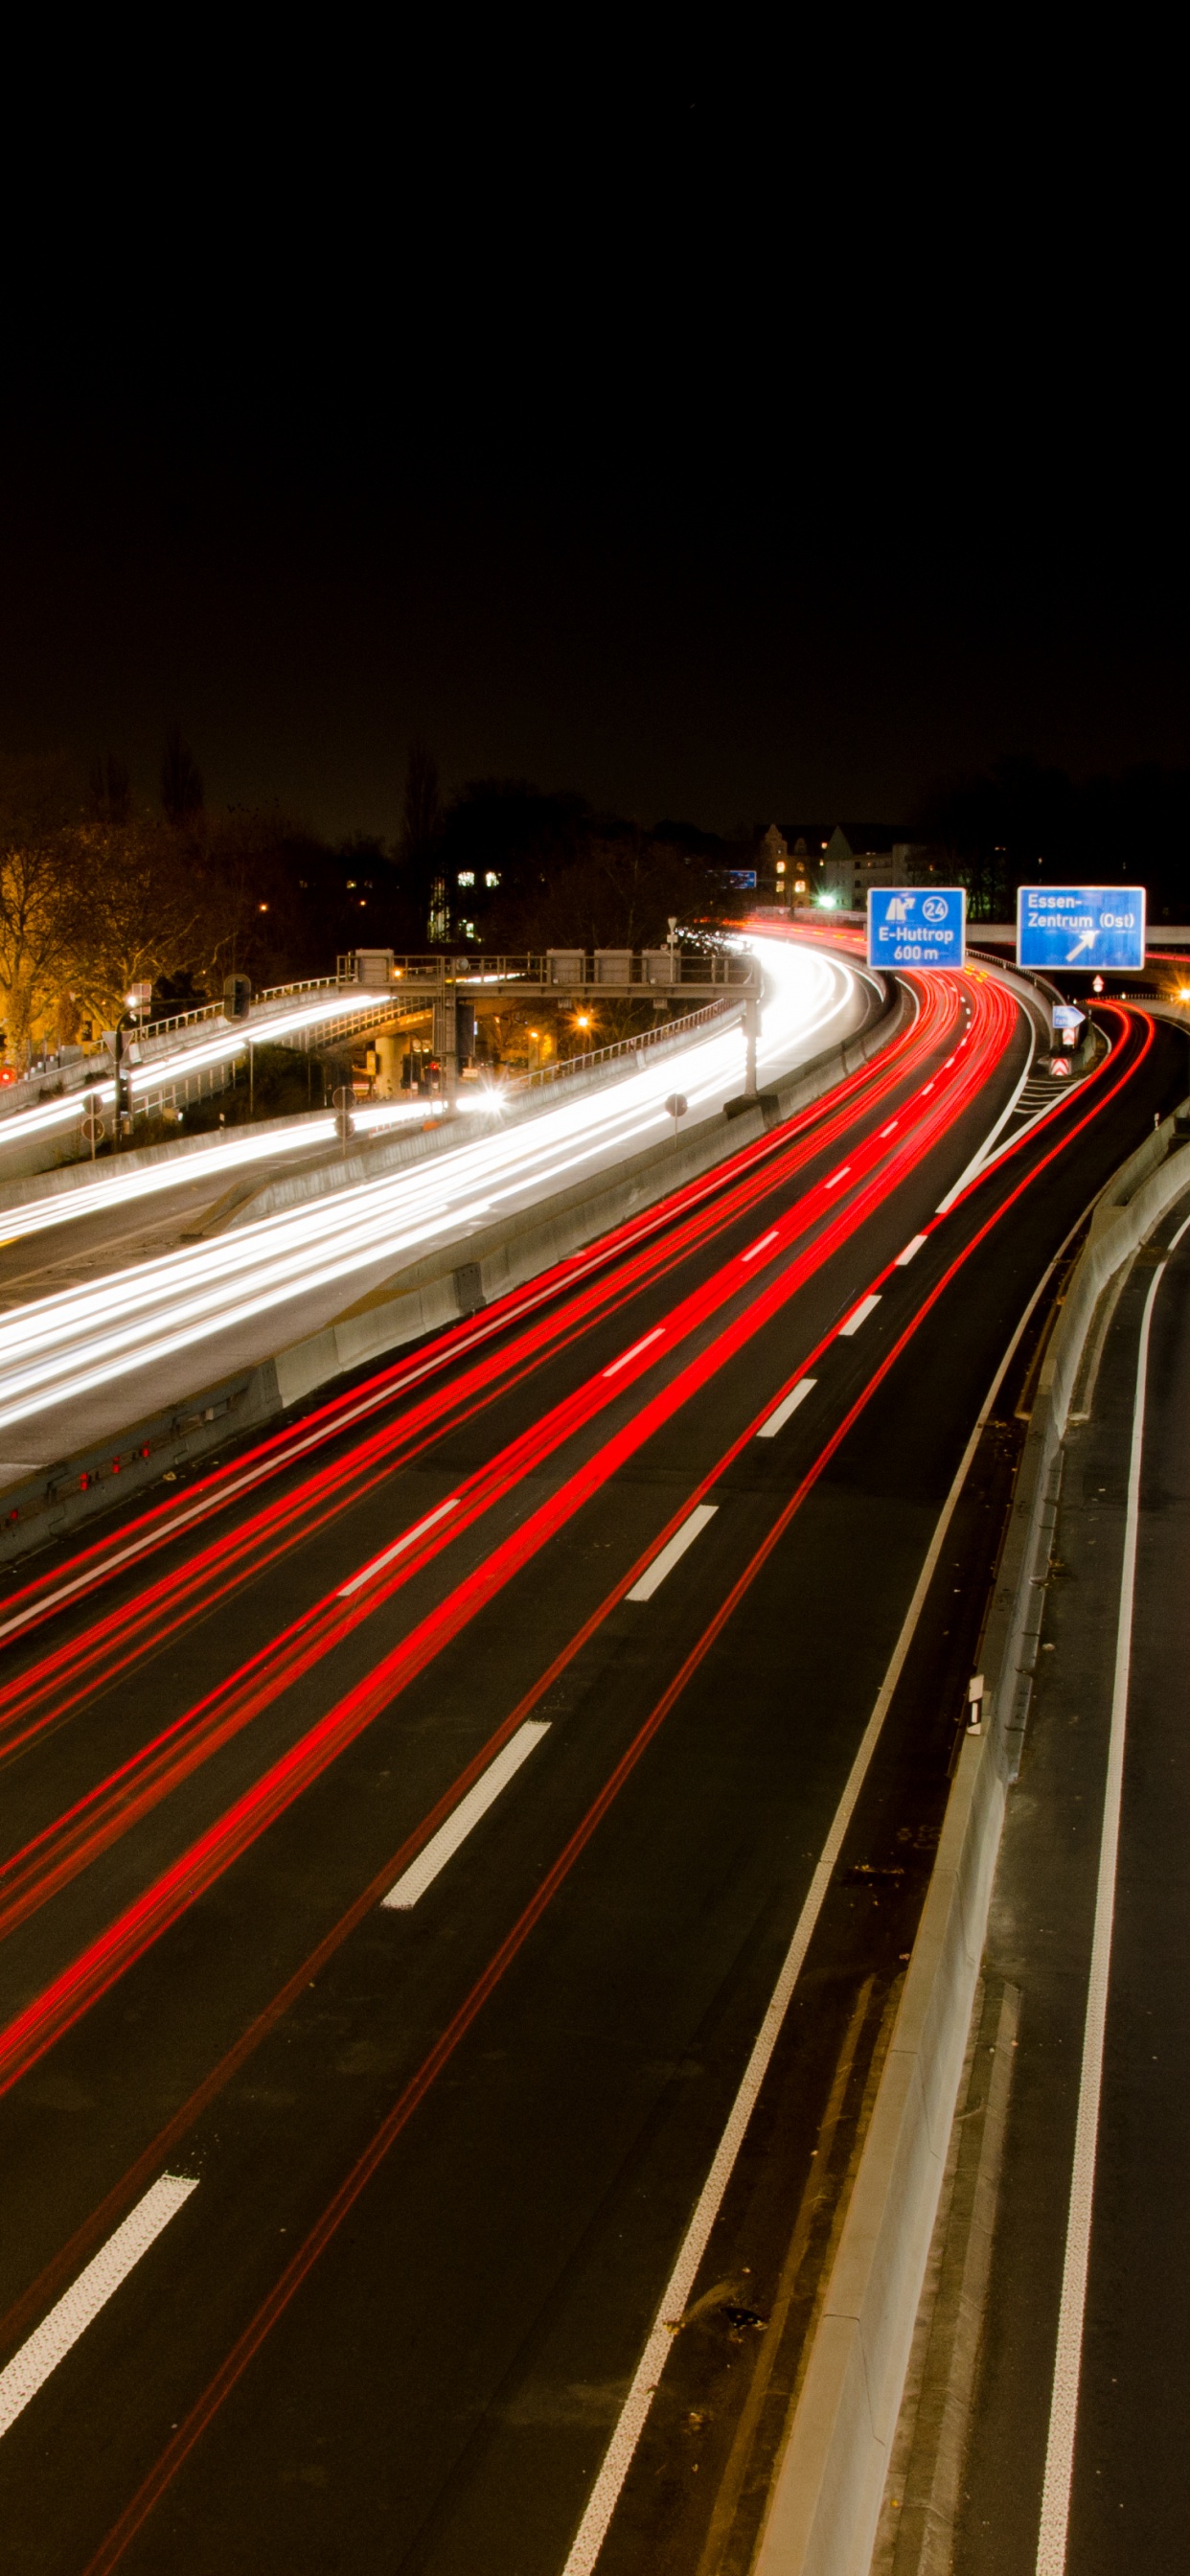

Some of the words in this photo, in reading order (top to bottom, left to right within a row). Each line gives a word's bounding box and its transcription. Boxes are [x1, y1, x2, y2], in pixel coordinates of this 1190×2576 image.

[1028, 893, 1083, 908] Essen-
[926, 902, 945, 917] 24
[1028, 912, 1092, 928] Zentrum
[1099, 913, 1134, 929] (Ost)
[879, 927, 953, 945] E-Huttrop
[894, 945, 922, 960] 600
[924, 949, 939, 960] m
